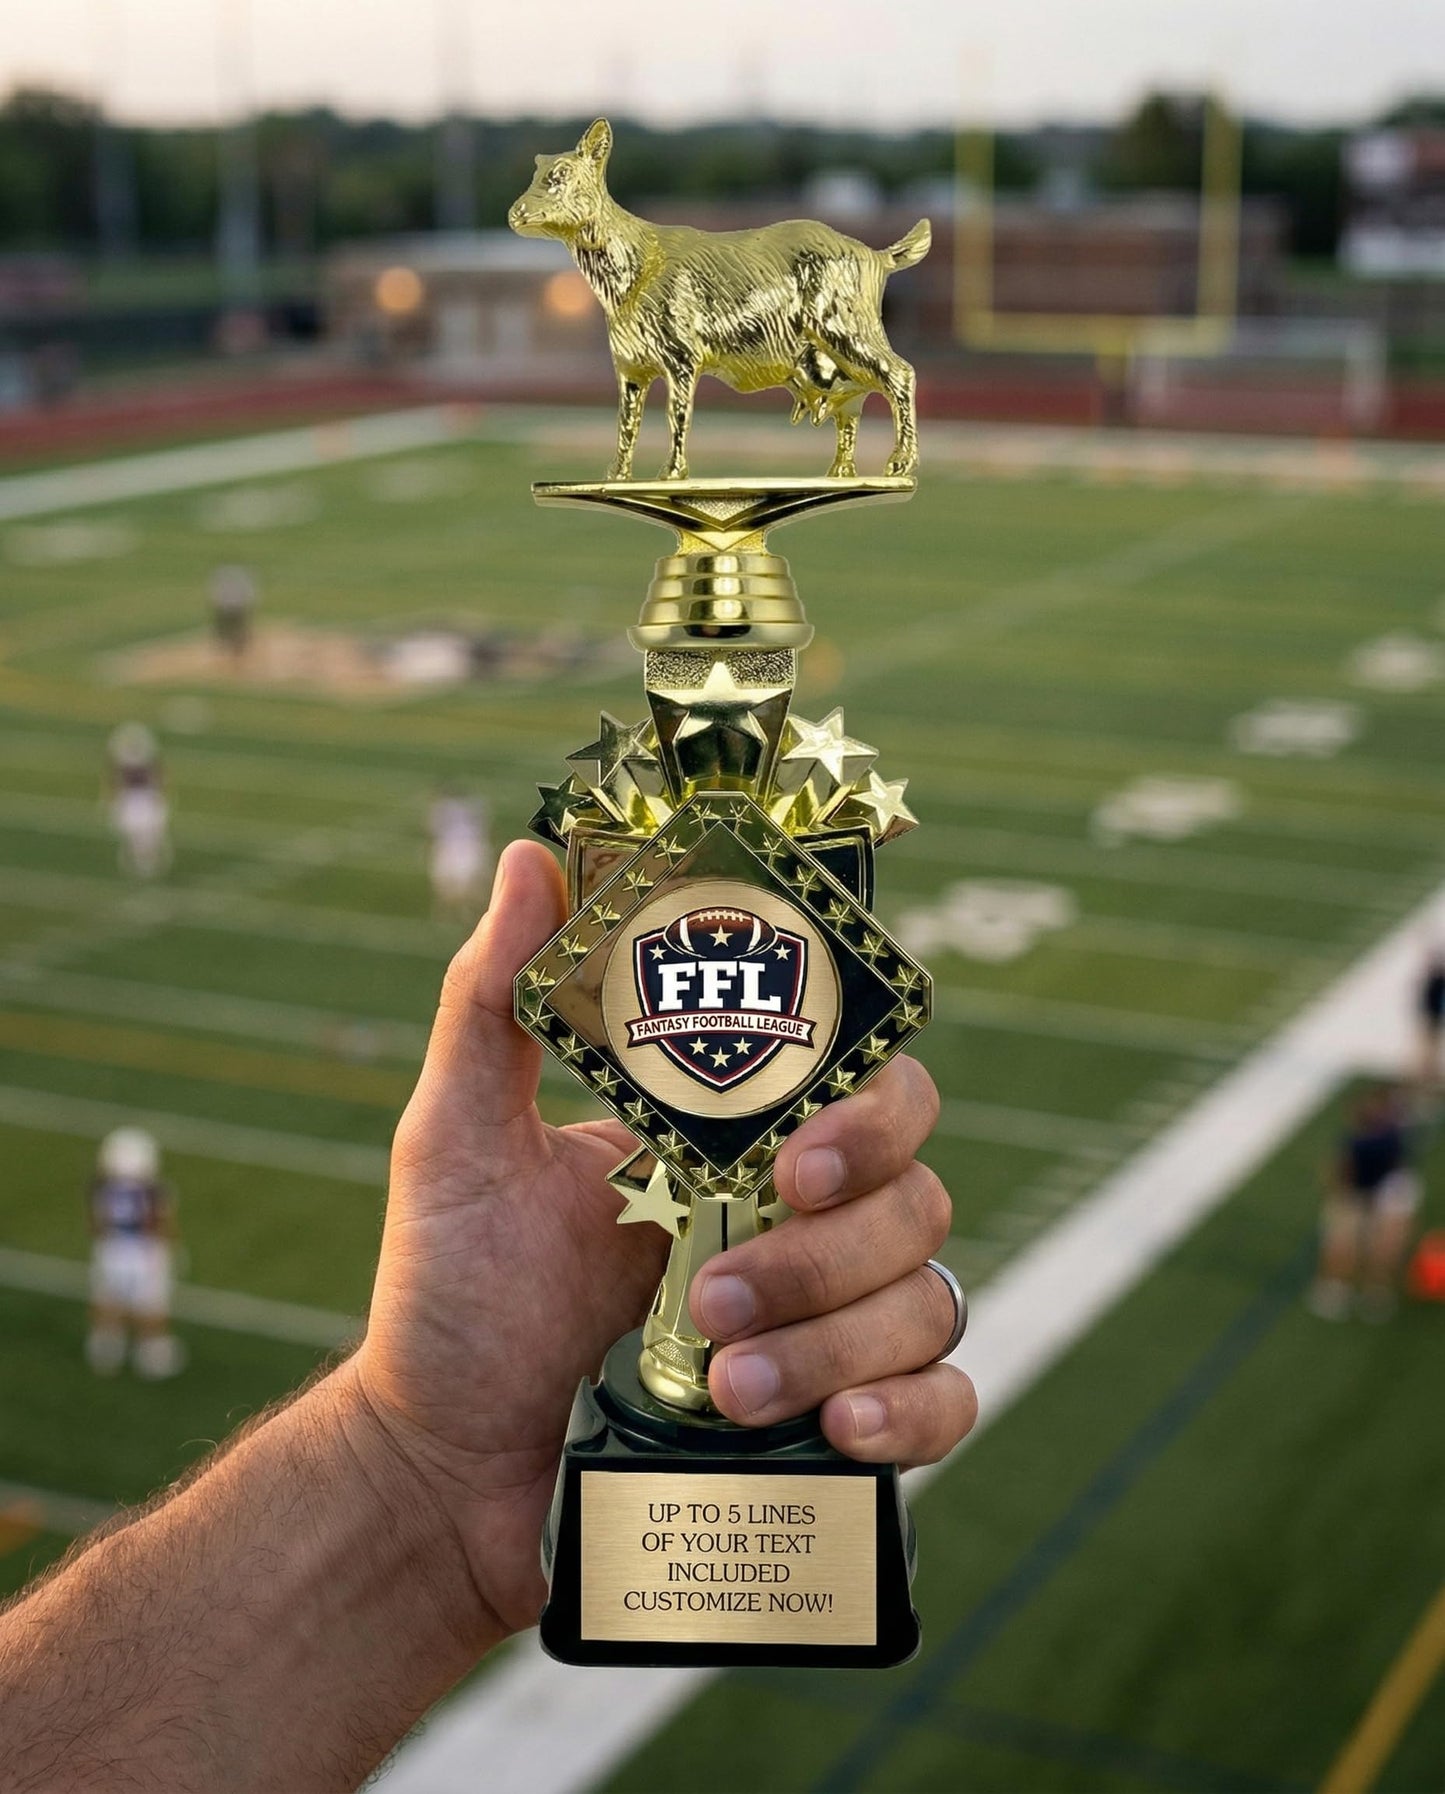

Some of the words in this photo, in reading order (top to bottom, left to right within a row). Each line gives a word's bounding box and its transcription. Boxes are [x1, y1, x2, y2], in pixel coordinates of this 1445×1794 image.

[658, 960, 782, 1013] FFL
[637, 1017, 690, 1036] FANTASY
[692, 1015, 754, 1030] FOOTBALL
[756, 1017, 804, 1036] LEAGUE
[648, 1503, 681, 1523] UP
[687, 1504, 720, 1524] TO
[728, 1504, 741, 1524] 5
[748, 1504, 816, 1525] LINES
[641, 1532, 675, 1552] OF
[681, 1533, 748, 1553] YOUR
[755, 1534, 816, 1554] TEXT
[667, 1562, 790, 1583] INCLUDED
[623, 1591, 762, 1612] CUSTOMIZE
[768, 1592, 833, 1613] NOW!
